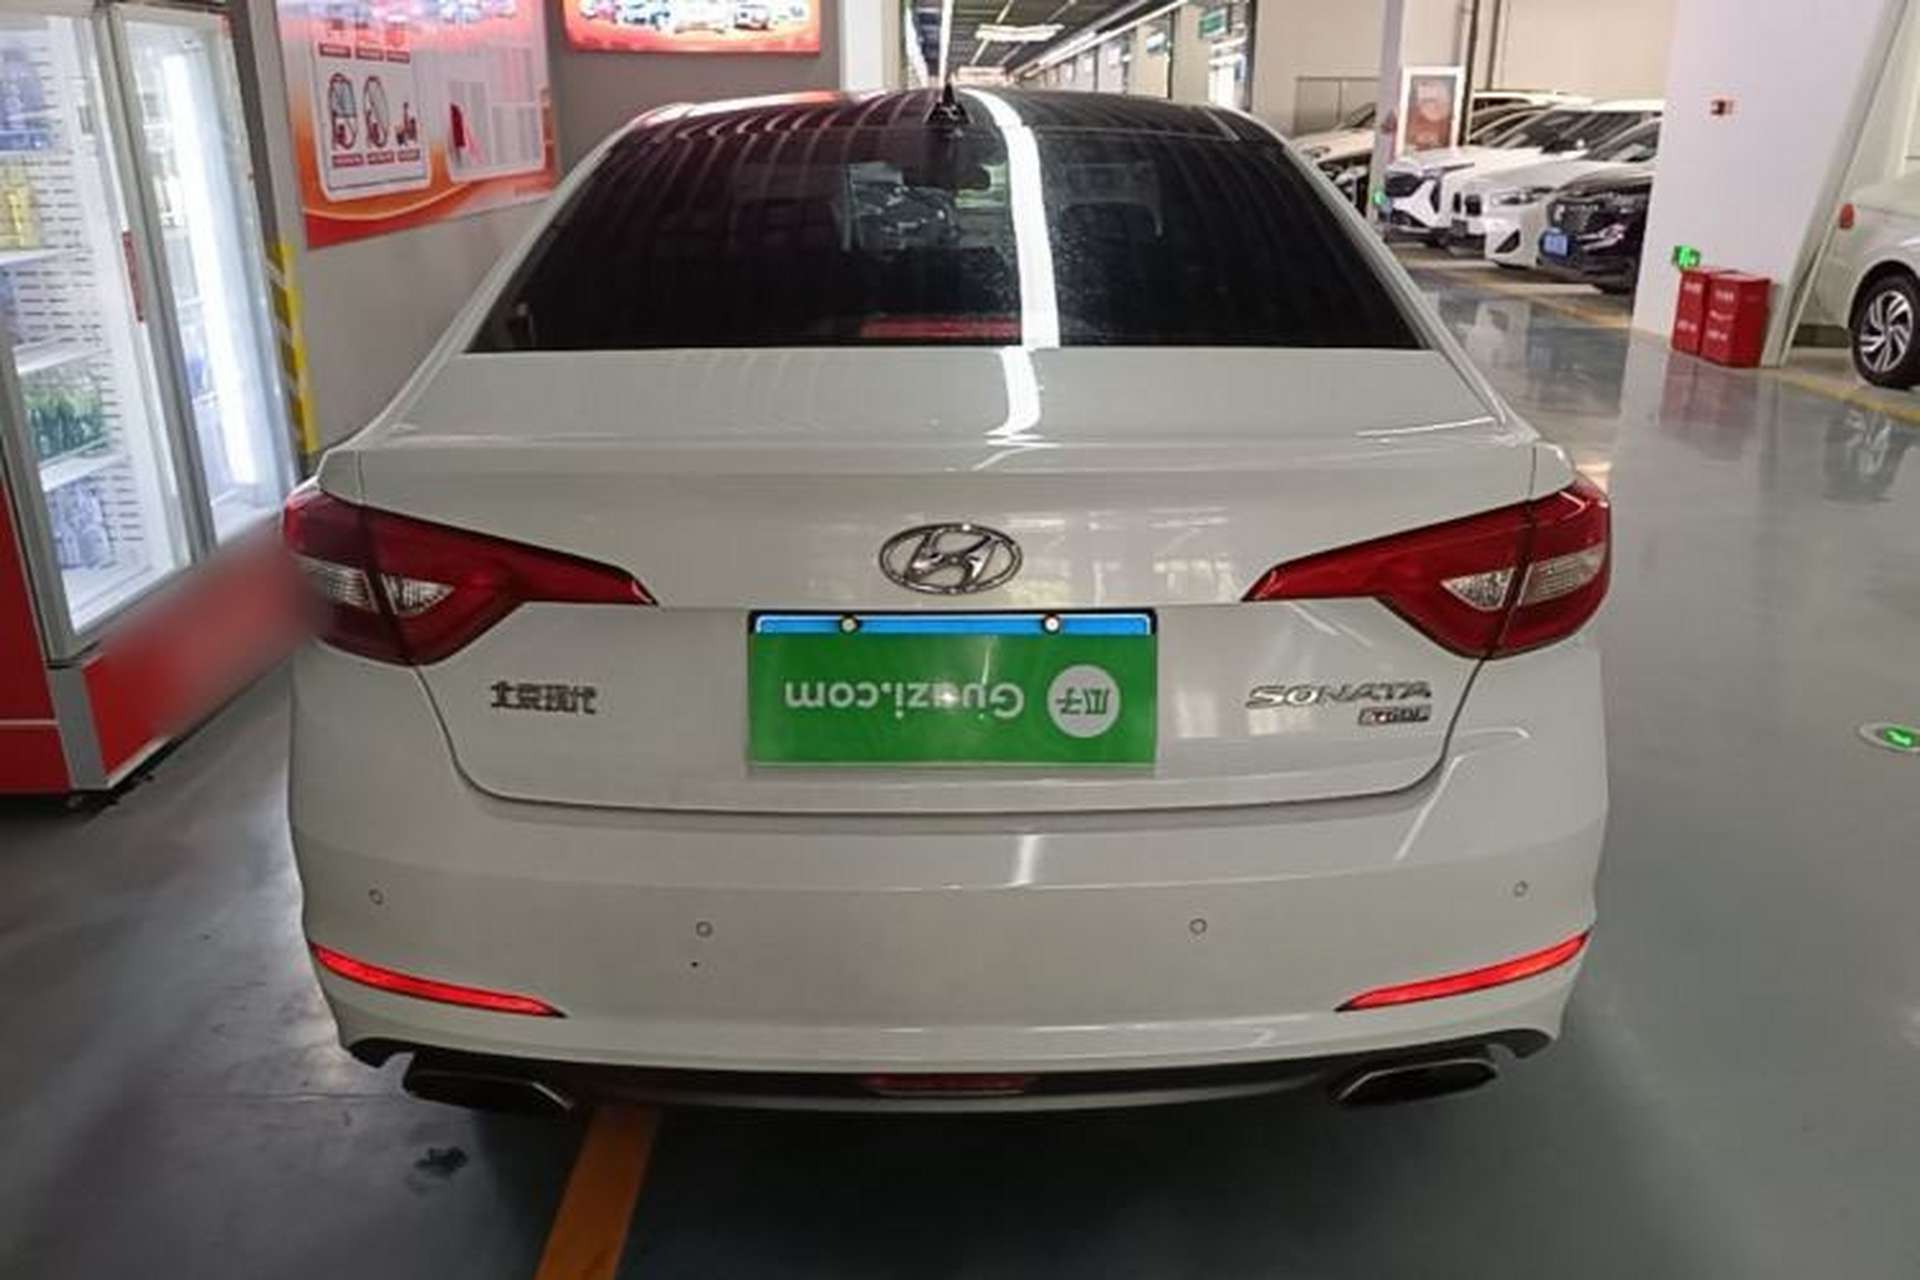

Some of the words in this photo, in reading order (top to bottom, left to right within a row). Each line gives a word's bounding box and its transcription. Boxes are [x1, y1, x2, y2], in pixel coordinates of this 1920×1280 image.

[490, 681, 597, 714] 北京现代
[784, 682, 1025, 719] Guazi.com
[1055, 687, 1109, 716] 瓜子
[1245, 681, 1432, 709] SONATA
